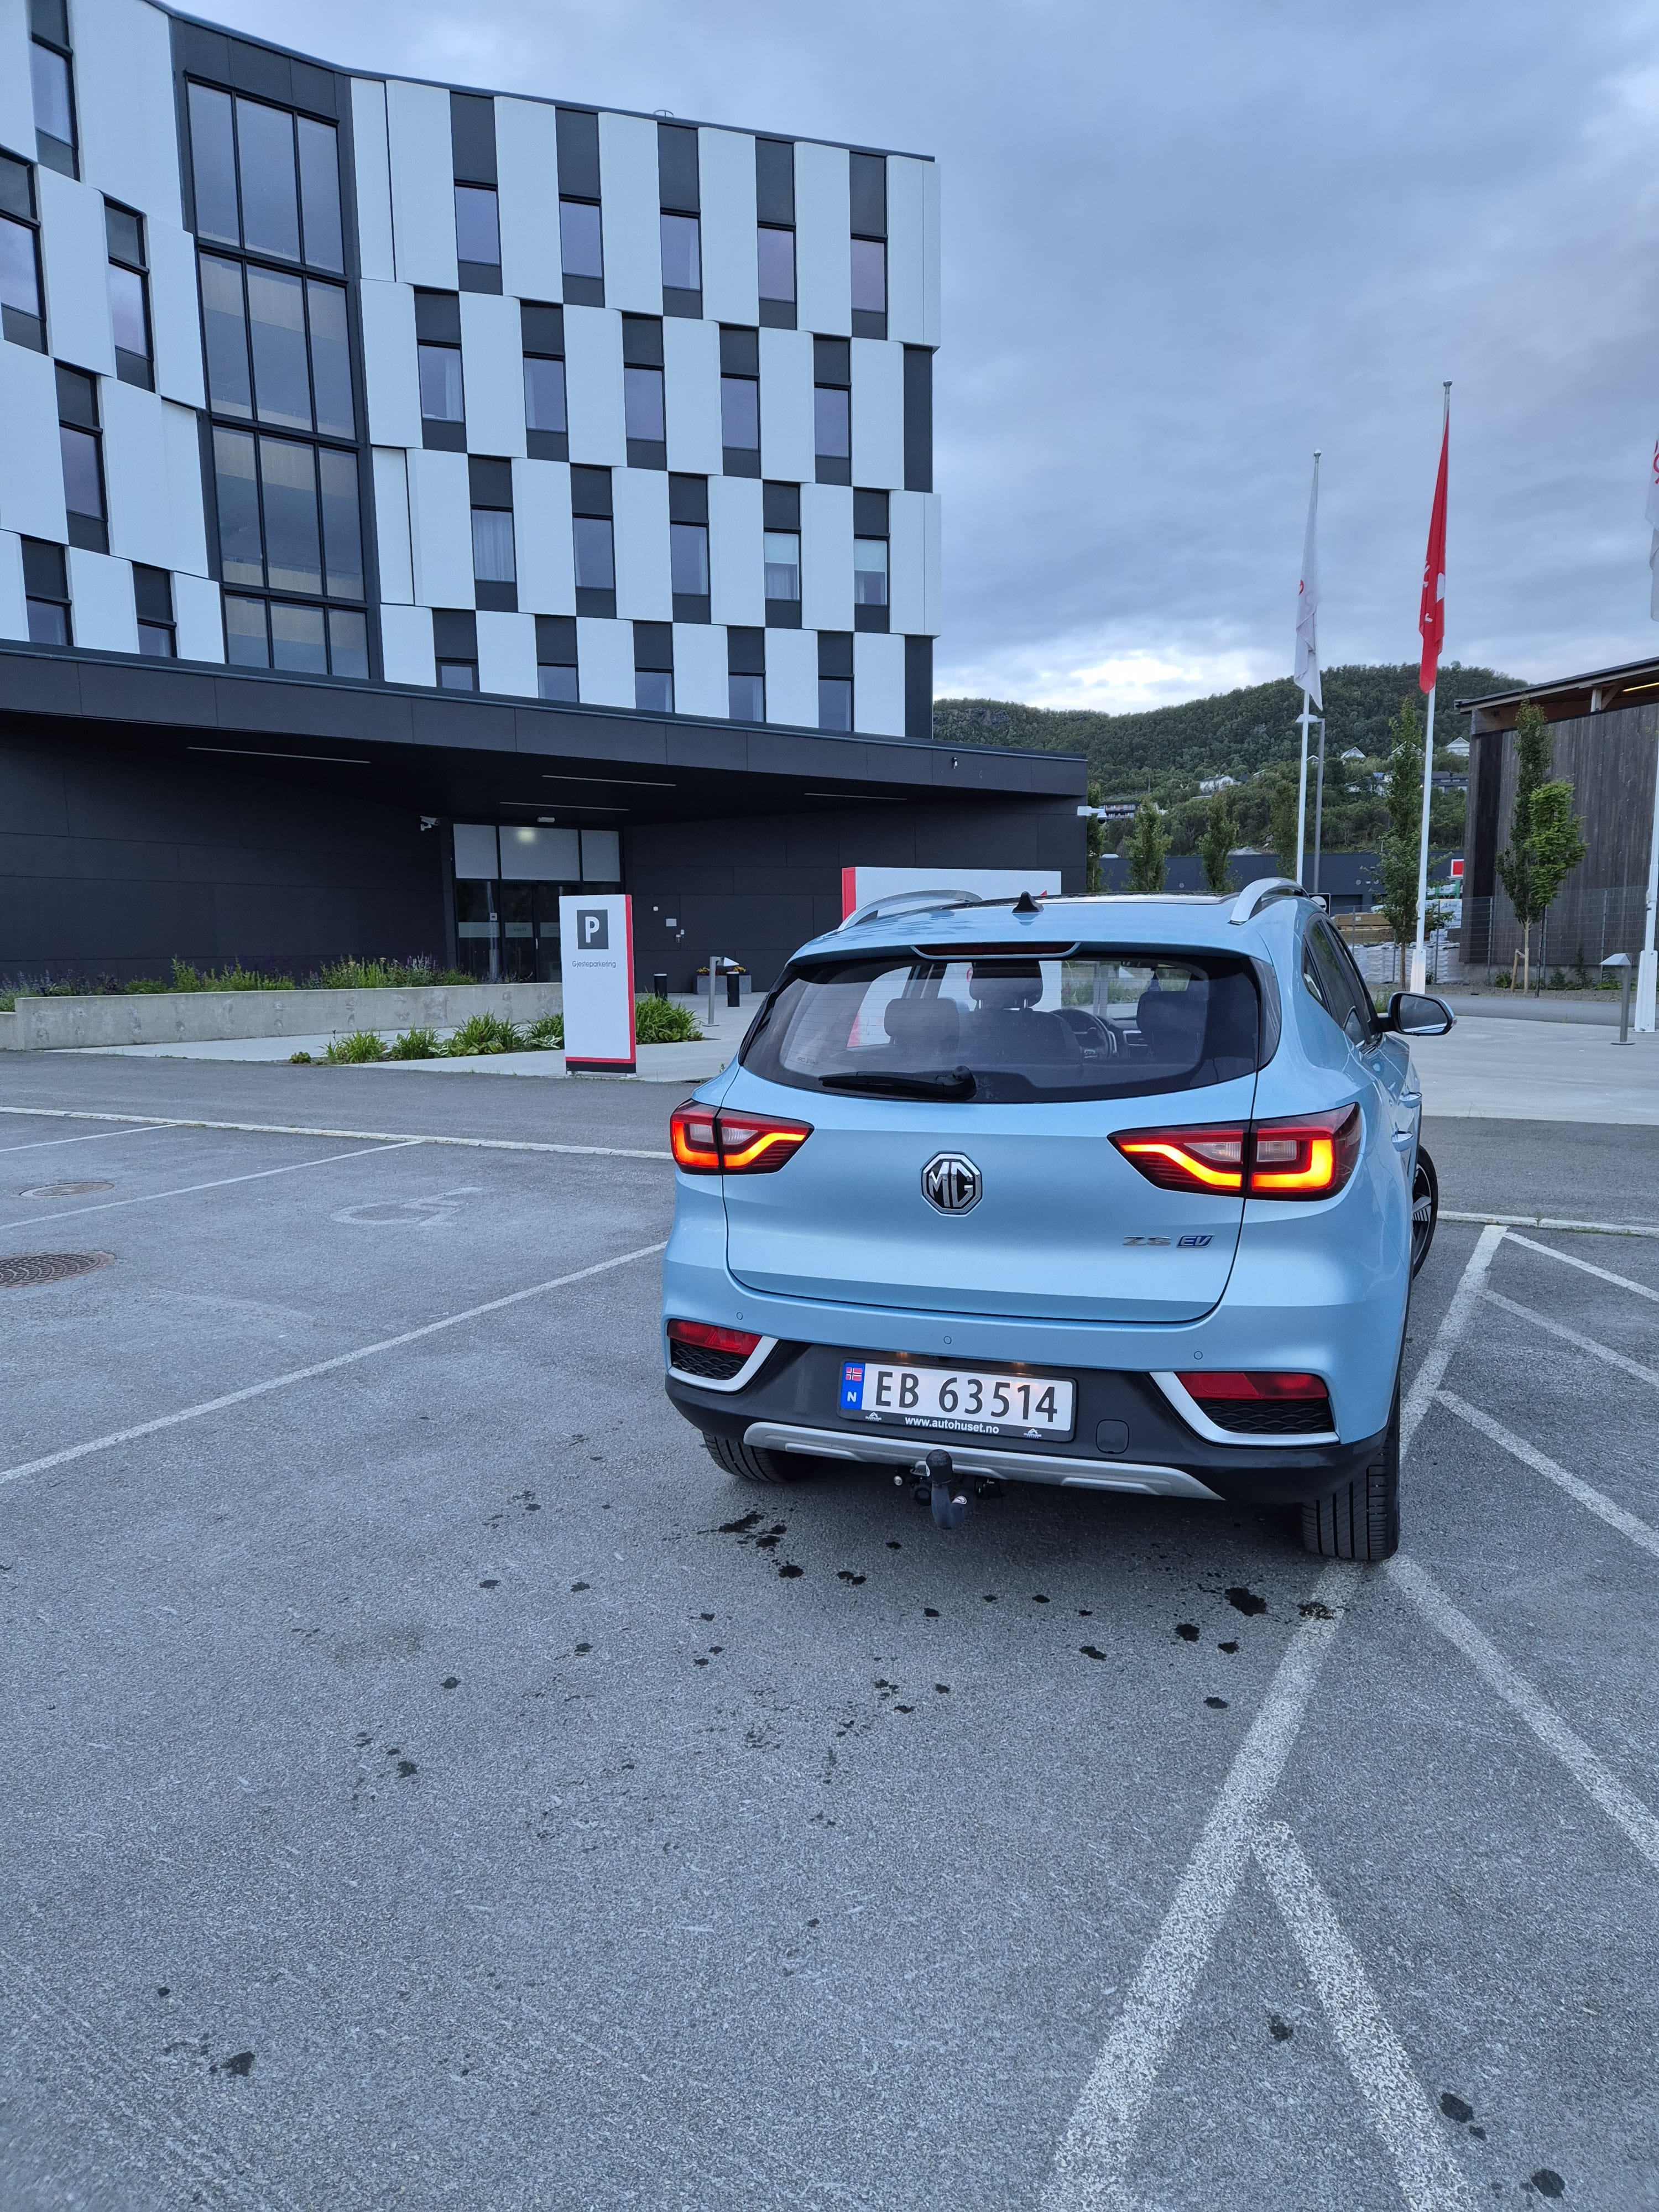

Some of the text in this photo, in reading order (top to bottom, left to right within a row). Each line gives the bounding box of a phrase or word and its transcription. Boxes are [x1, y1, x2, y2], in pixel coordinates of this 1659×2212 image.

[585, 916, 599, 943] P
[929, 1161, 974, 1207] MG
[1123, 1236, 1213, 1246] ZS EV
[847, 1392, 857, 1402] N
[875, 1371, 1057, 1422] EB 63514
[905, 1417, 999, 1434] www.autohuset.no
